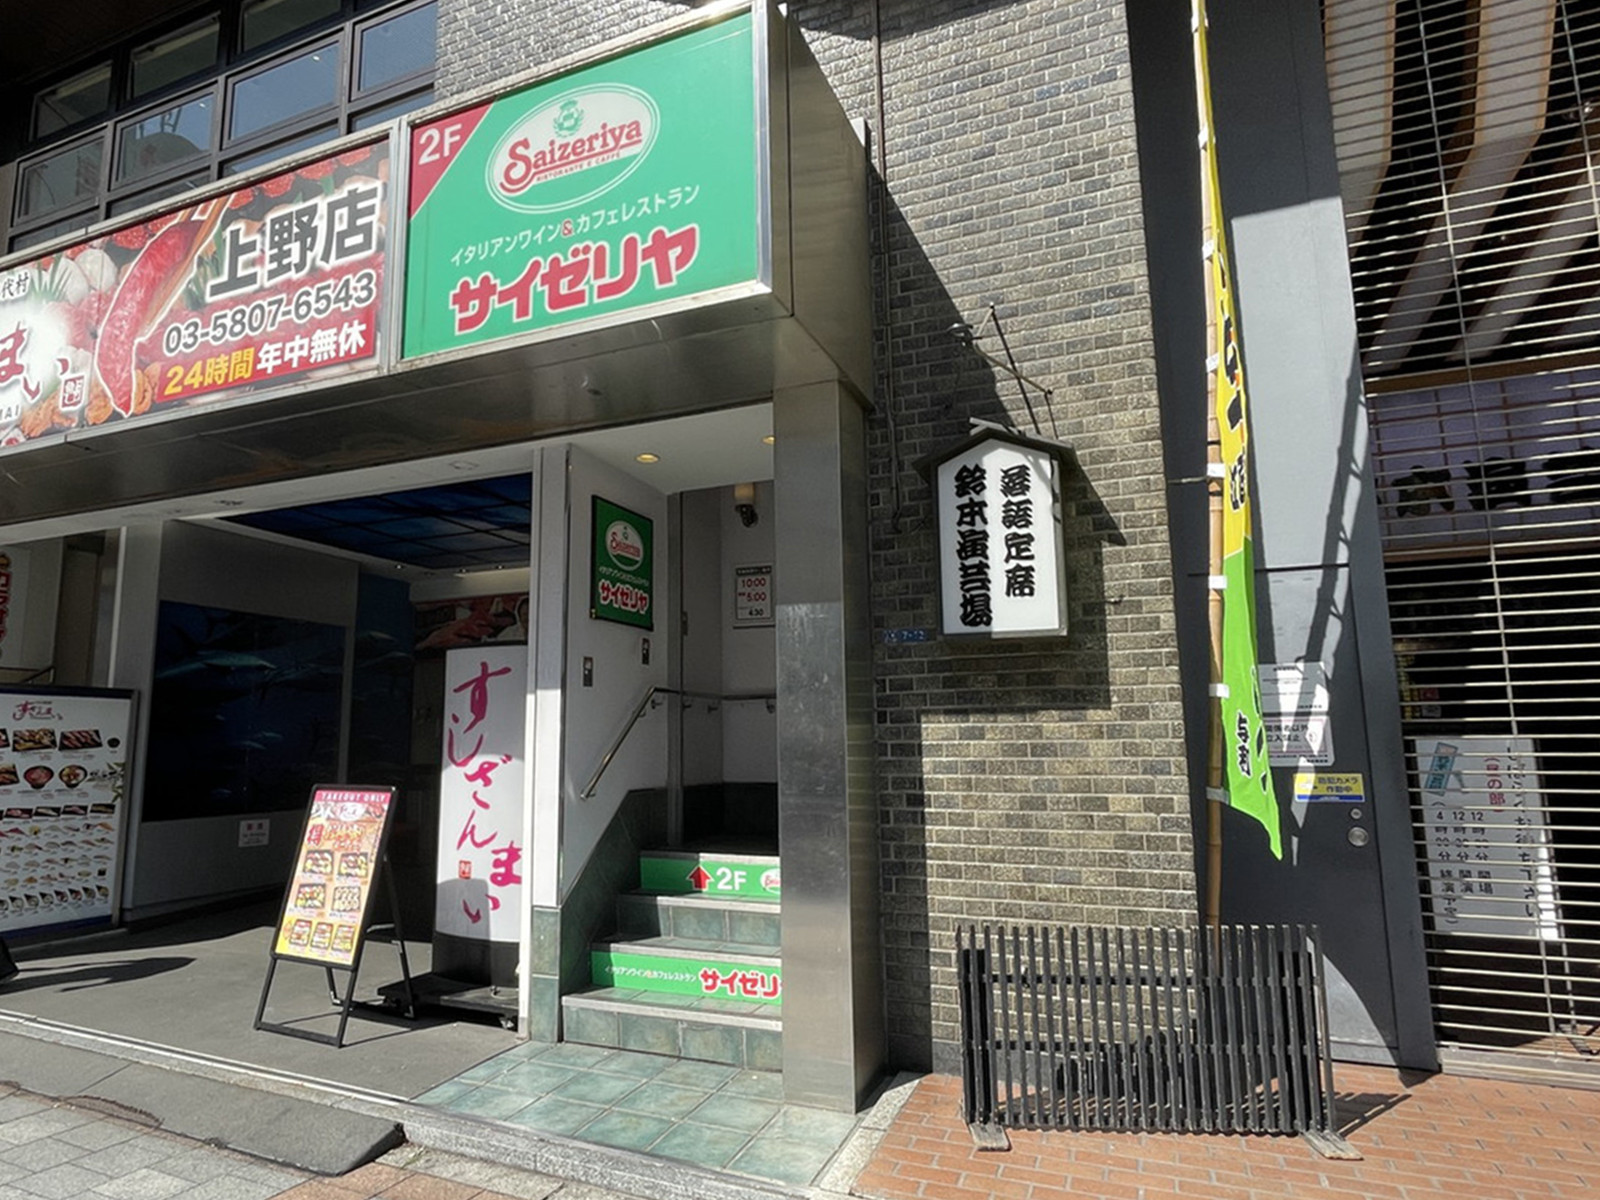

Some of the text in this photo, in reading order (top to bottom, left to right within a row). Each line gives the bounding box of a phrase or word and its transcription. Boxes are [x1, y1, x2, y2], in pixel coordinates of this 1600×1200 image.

[418, 124, 463, 164] 2F
[499, 119, 643, 194] Saizeriya
[208, 186, 382, 299] 上野店
[450, 184, 700, 267] イタリアンワイン&カフェレストラン
[164, 272, 374, 353] 03-5807-6543
[452, 225, 698, 333] サイゼリヤ
[163, 321, 367, 396] 24時間 年中無休
[954, 464, 993, 627] 鈴本演芸場
[1000, 464, 1036, 597] 落語定席
[600, 579, 649, 613] サイゼリヤ
[741, 577, 767, 588] 10:00
[321, 793, 361, 802] TAKEOUT
[448, 661, 522, 924] すしざんまい
[716, 868, 747, 891] 2F
